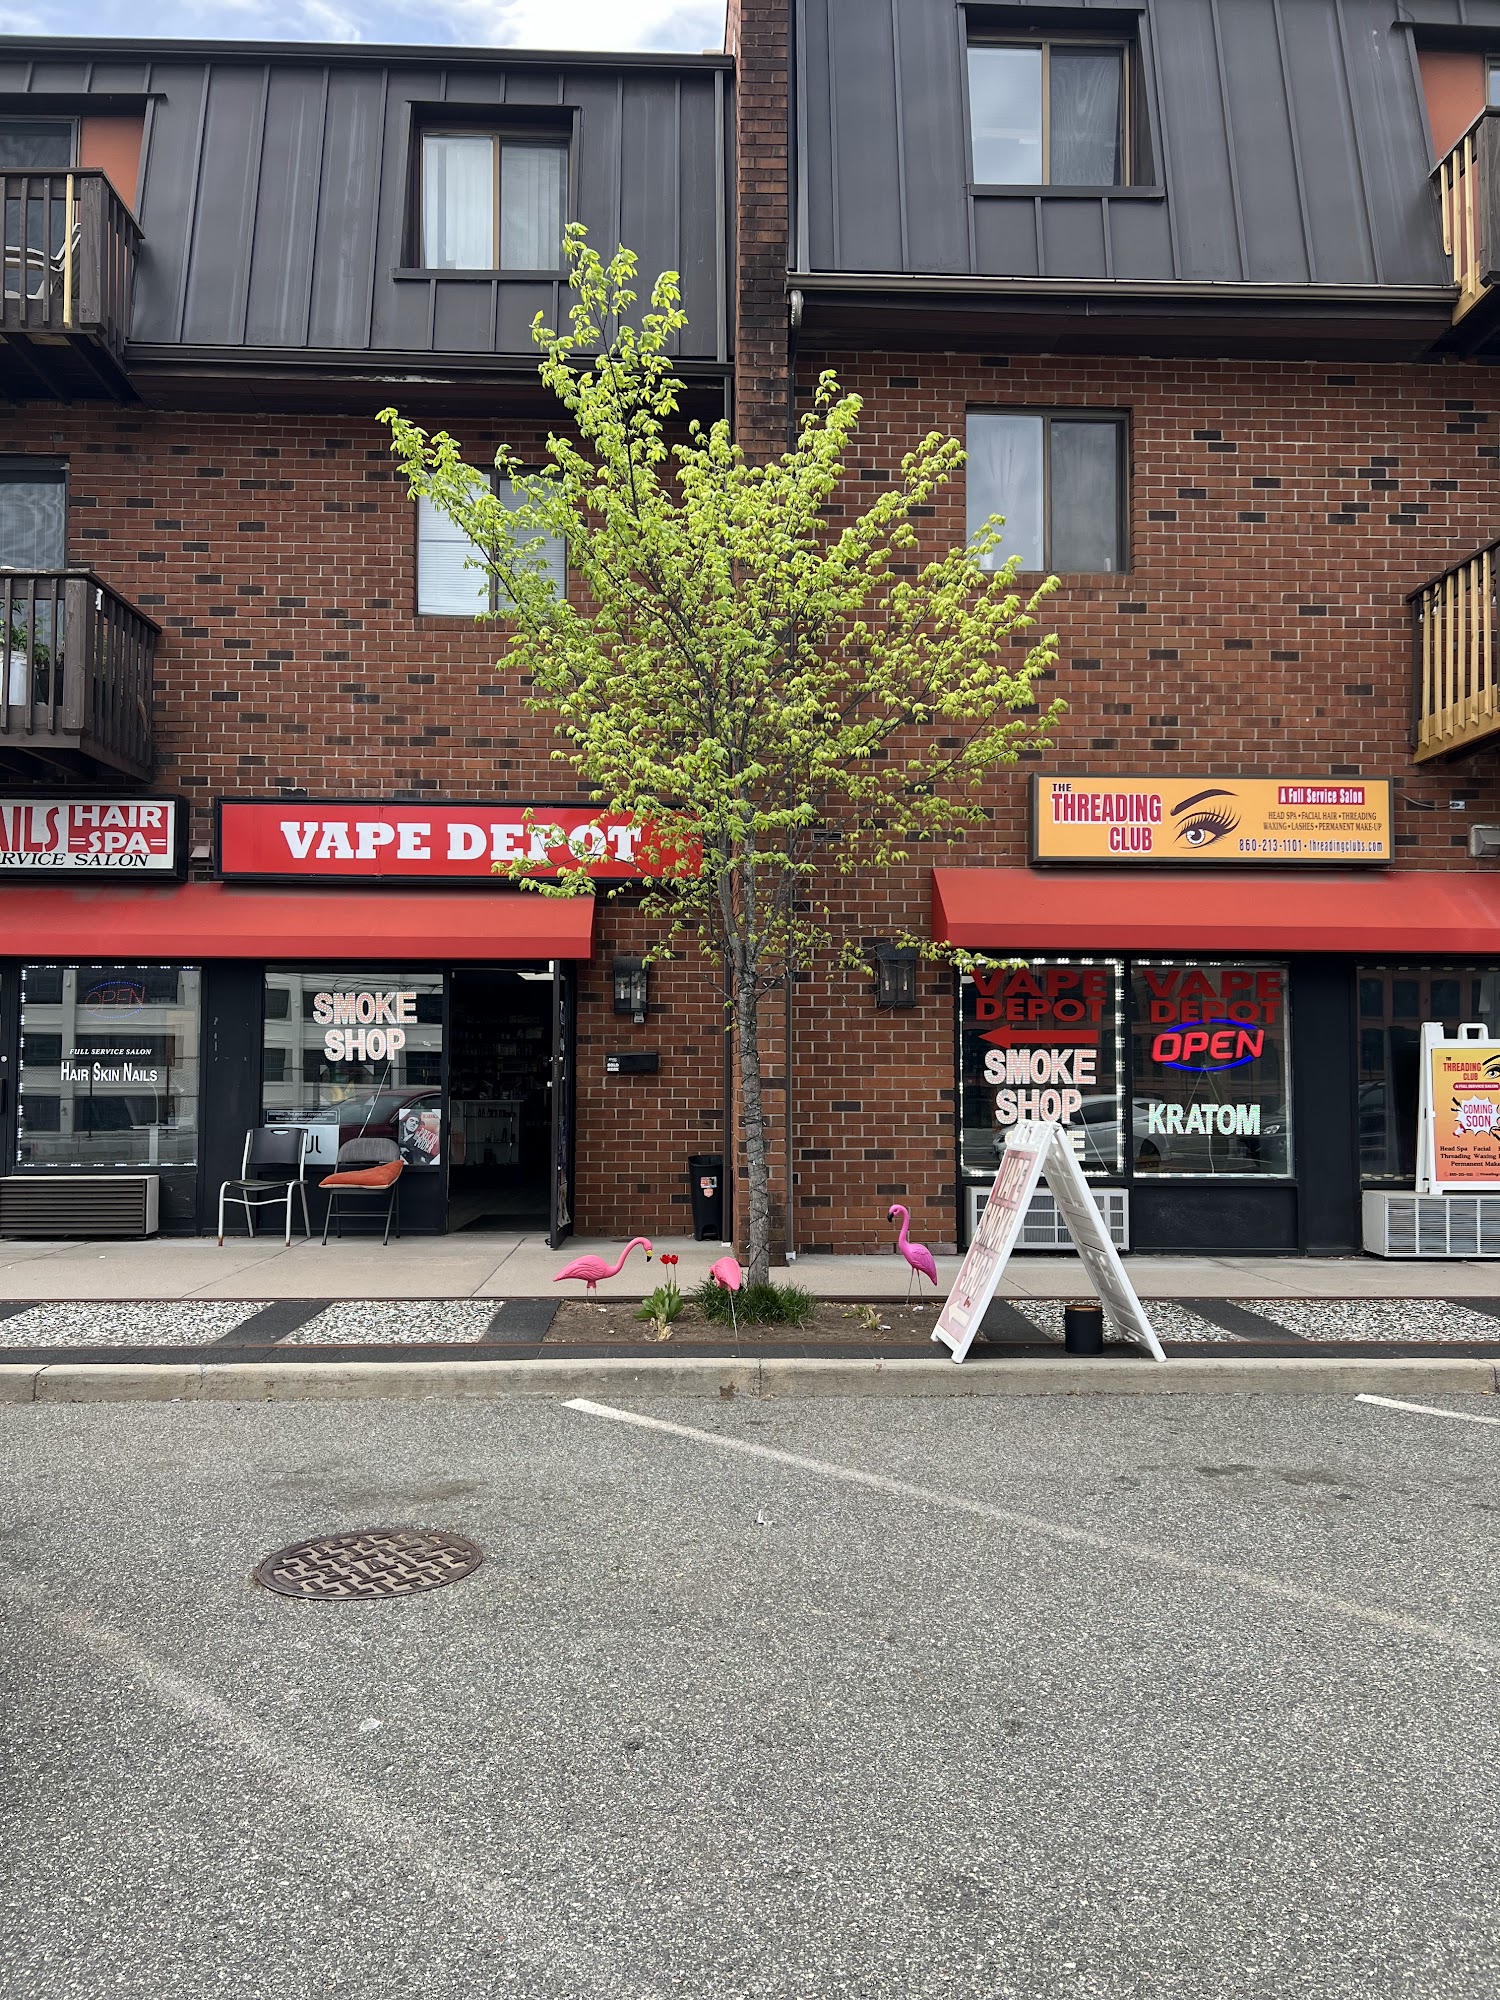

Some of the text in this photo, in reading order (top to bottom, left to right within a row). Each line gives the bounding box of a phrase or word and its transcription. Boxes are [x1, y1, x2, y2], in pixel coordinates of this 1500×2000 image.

[1052, 783, 1072, 792] THE
[1280, 788, 1363, 804] A Full Service Salon
[74, 805, 162, 828] HAIR
[1051, 793, 1162, 822] THREADING
[1268, 812, 1377, 821] HEAD SPA FACIAL HAIR THREADING
[1109, 827, 1153, 851] CLUB
[1263, 823, 1382, 831] WAXING LASHES PERMANENT MAKE-UP
[88, 831, 150, 853] SPA
[280, 821, 642, 862] VAPE DEPOT
[1239, 838, 1383, 853] 860-213-1101 threadingclubs.com
[0, 853, 150, 867] RVICE SALON
[971, 969, 1108, 997] VAPE
[1142, 970, 1281, 999] VAPE
[85, 987, 145, 1013] OPEN
[313, 991, 418, 1025] SMOKE
[975, 997, 1106, 1023] DEPOT
[1150, 1000, 1280, 1024] DEPOT
[324, 1028, 406, 1061] SHOP
[1152, 1029, 1265, 1062] OPEN
[984, 1049, 1097, 1085] SMOKE
[1443, 1062, 1482, 1072] THREADING
[1463, 1072, 1479, 1081] CLUB
[995, 1088, 1083, 1125] SHOP
[1148, 1103, 1261, 1136] KRATOM
[1463, 1104, 1493, 1114] COMING
[1466, 1115, 1491, 1127] SOON
[997, 1156, 1031, 1204] VAPE
[975, 1202, 1018, 1254] SMOKE
[959, 1250, 994, 1301] SHOP
